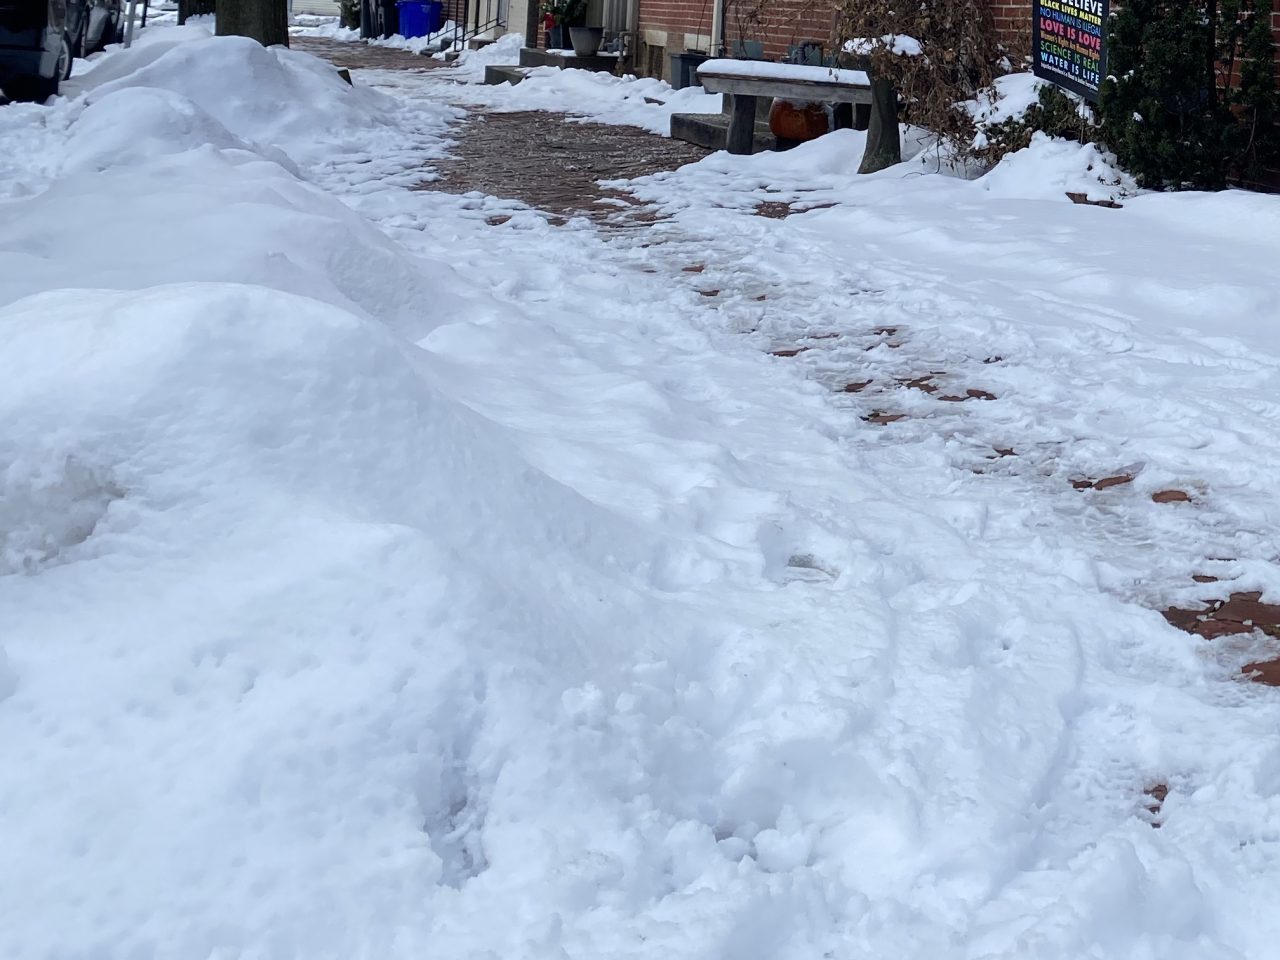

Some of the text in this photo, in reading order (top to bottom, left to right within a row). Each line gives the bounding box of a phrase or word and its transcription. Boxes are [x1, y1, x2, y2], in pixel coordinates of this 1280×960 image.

[1039, 6, 1051, 17] NO
[1052, 10, 1075, 26] HUMAN
[1082, 20, 1101, 37] ILLEGAL
[1061, 4, 1078, 17] LIVES
[1079, 10, 1102, 26] MATTER
[1040, 17, 1101, 50] LOVE IS LOVE
[1040, 40, 1099, 73] SCIENCE IS REAL
[1040, 51, 1069, 71] WATER
[1071, 63, 1079, 75] IS
[1082, 68, 1099, 84] LIFE
